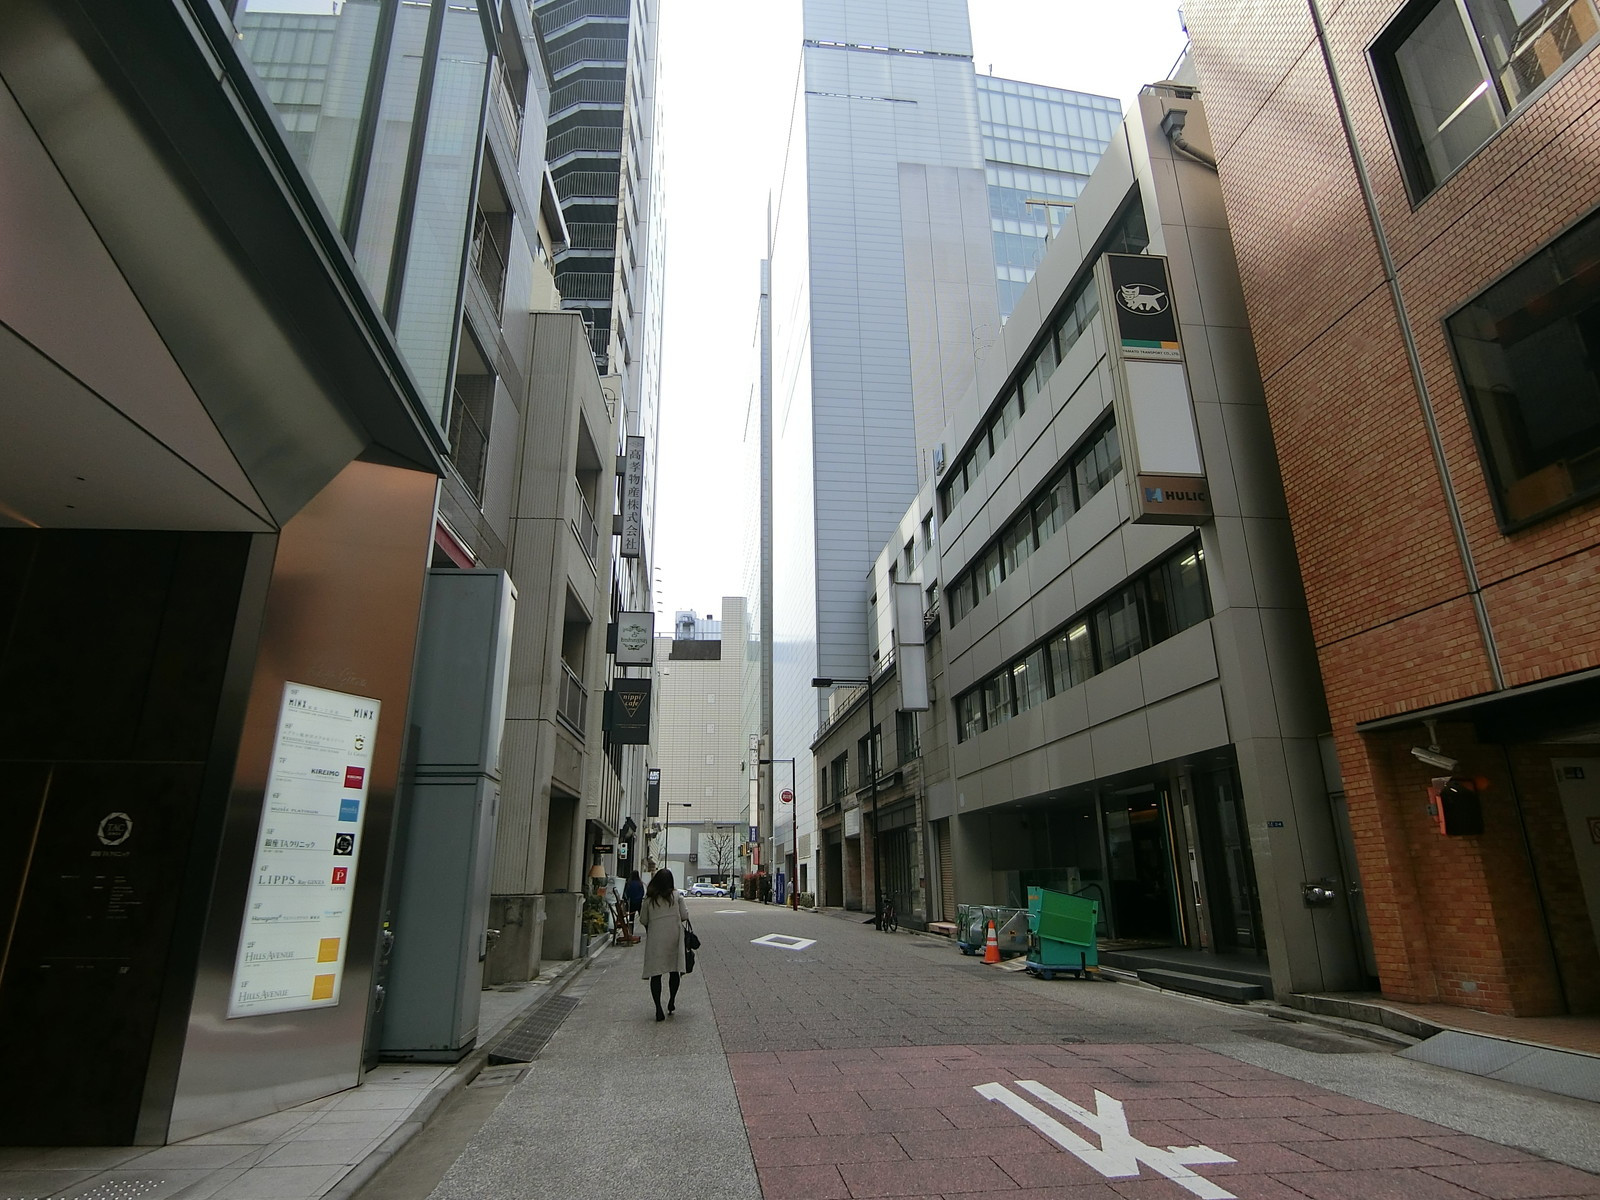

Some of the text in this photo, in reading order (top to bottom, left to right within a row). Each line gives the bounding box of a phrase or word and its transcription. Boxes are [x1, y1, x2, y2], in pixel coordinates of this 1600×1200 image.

[1165, 491, 1206, 501] HULIC
[289, 699, 306, 708] MINX
[353, 709, 373, 720] MINX
[311, 769, 340, 777] KIREIMO
[258, 875, 296, 885] LIPPS
[244, 951, 294, 962] HILLS AVENUE
[238, 990, 288, 1002] HILLS AVENUE
